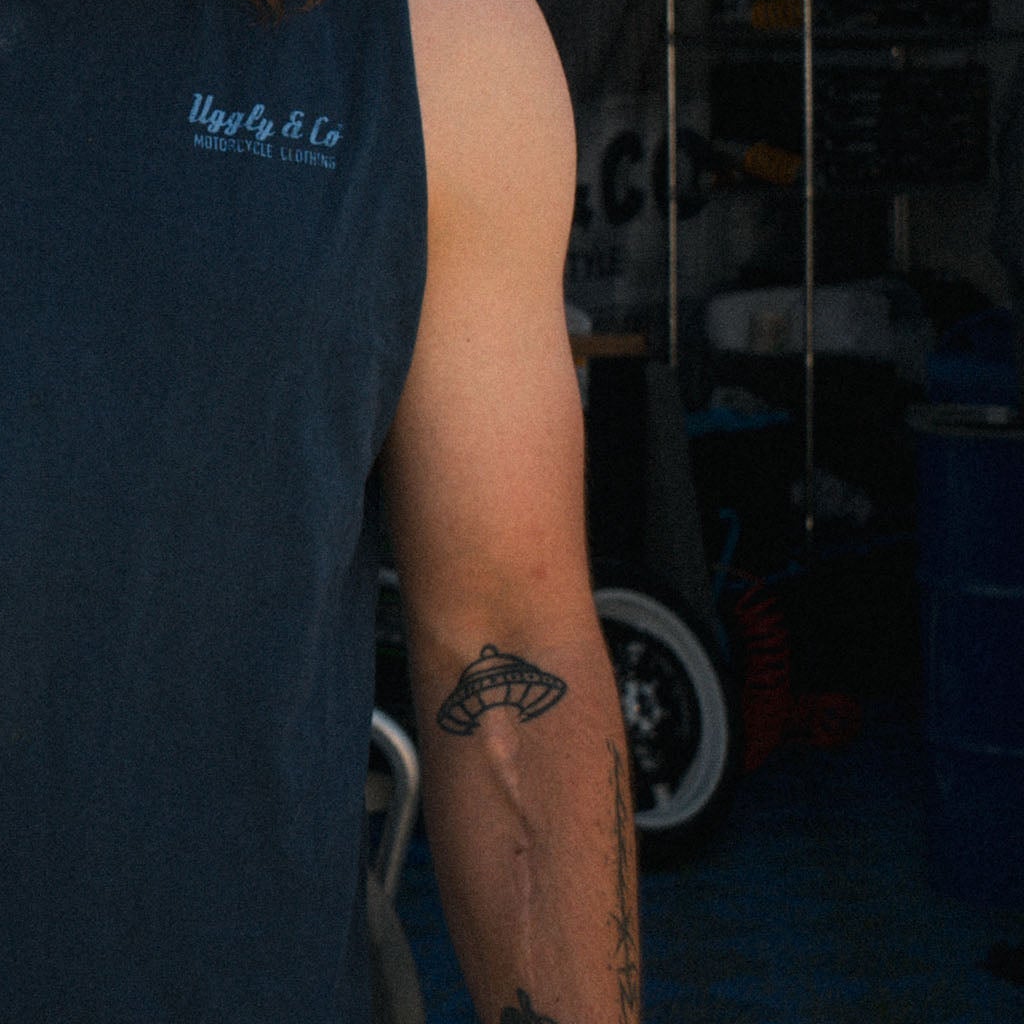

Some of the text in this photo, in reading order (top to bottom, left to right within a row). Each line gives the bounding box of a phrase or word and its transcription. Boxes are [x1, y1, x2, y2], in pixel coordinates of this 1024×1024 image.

[188, 93, 344, 147] Uggly & Co
[193, 134, 337, 169] MOTORCYCLE CLOTHING
